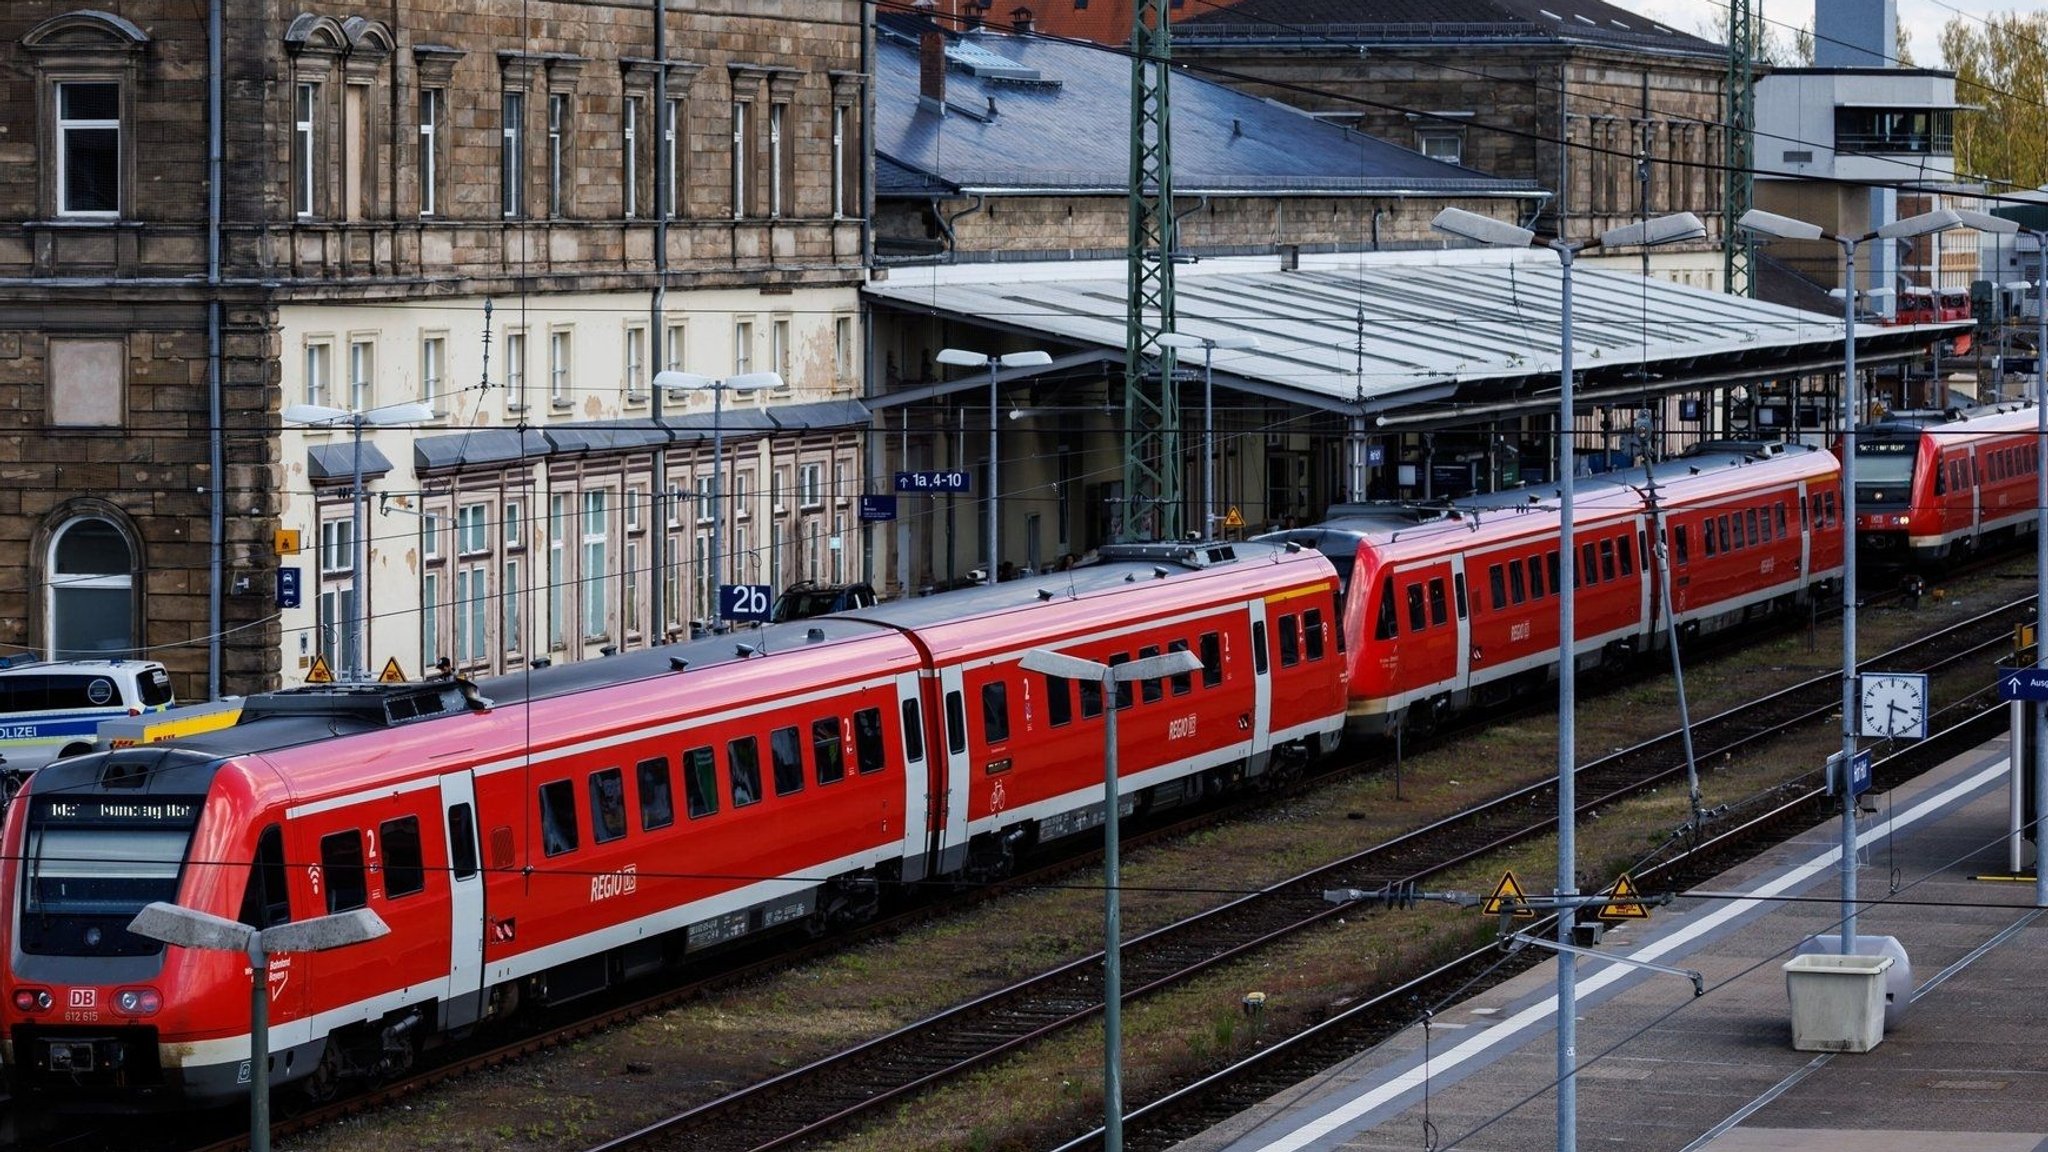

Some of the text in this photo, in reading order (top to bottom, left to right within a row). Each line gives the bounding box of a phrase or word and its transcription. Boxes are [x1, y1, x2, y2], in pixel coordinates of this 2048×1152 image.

[733, 585, 767, 613] 2b
[1024, 678, 1030, 700] 2
[844, 718, 851, 741] 2
[1169, 717, 1188, 740] REGIO
[367, 829, 376, 857] 2
[590, 869, 622, 902] REGIO
[71, 990, 94, 1006] DB
[64, 1011, 98, 1022] 612 615
